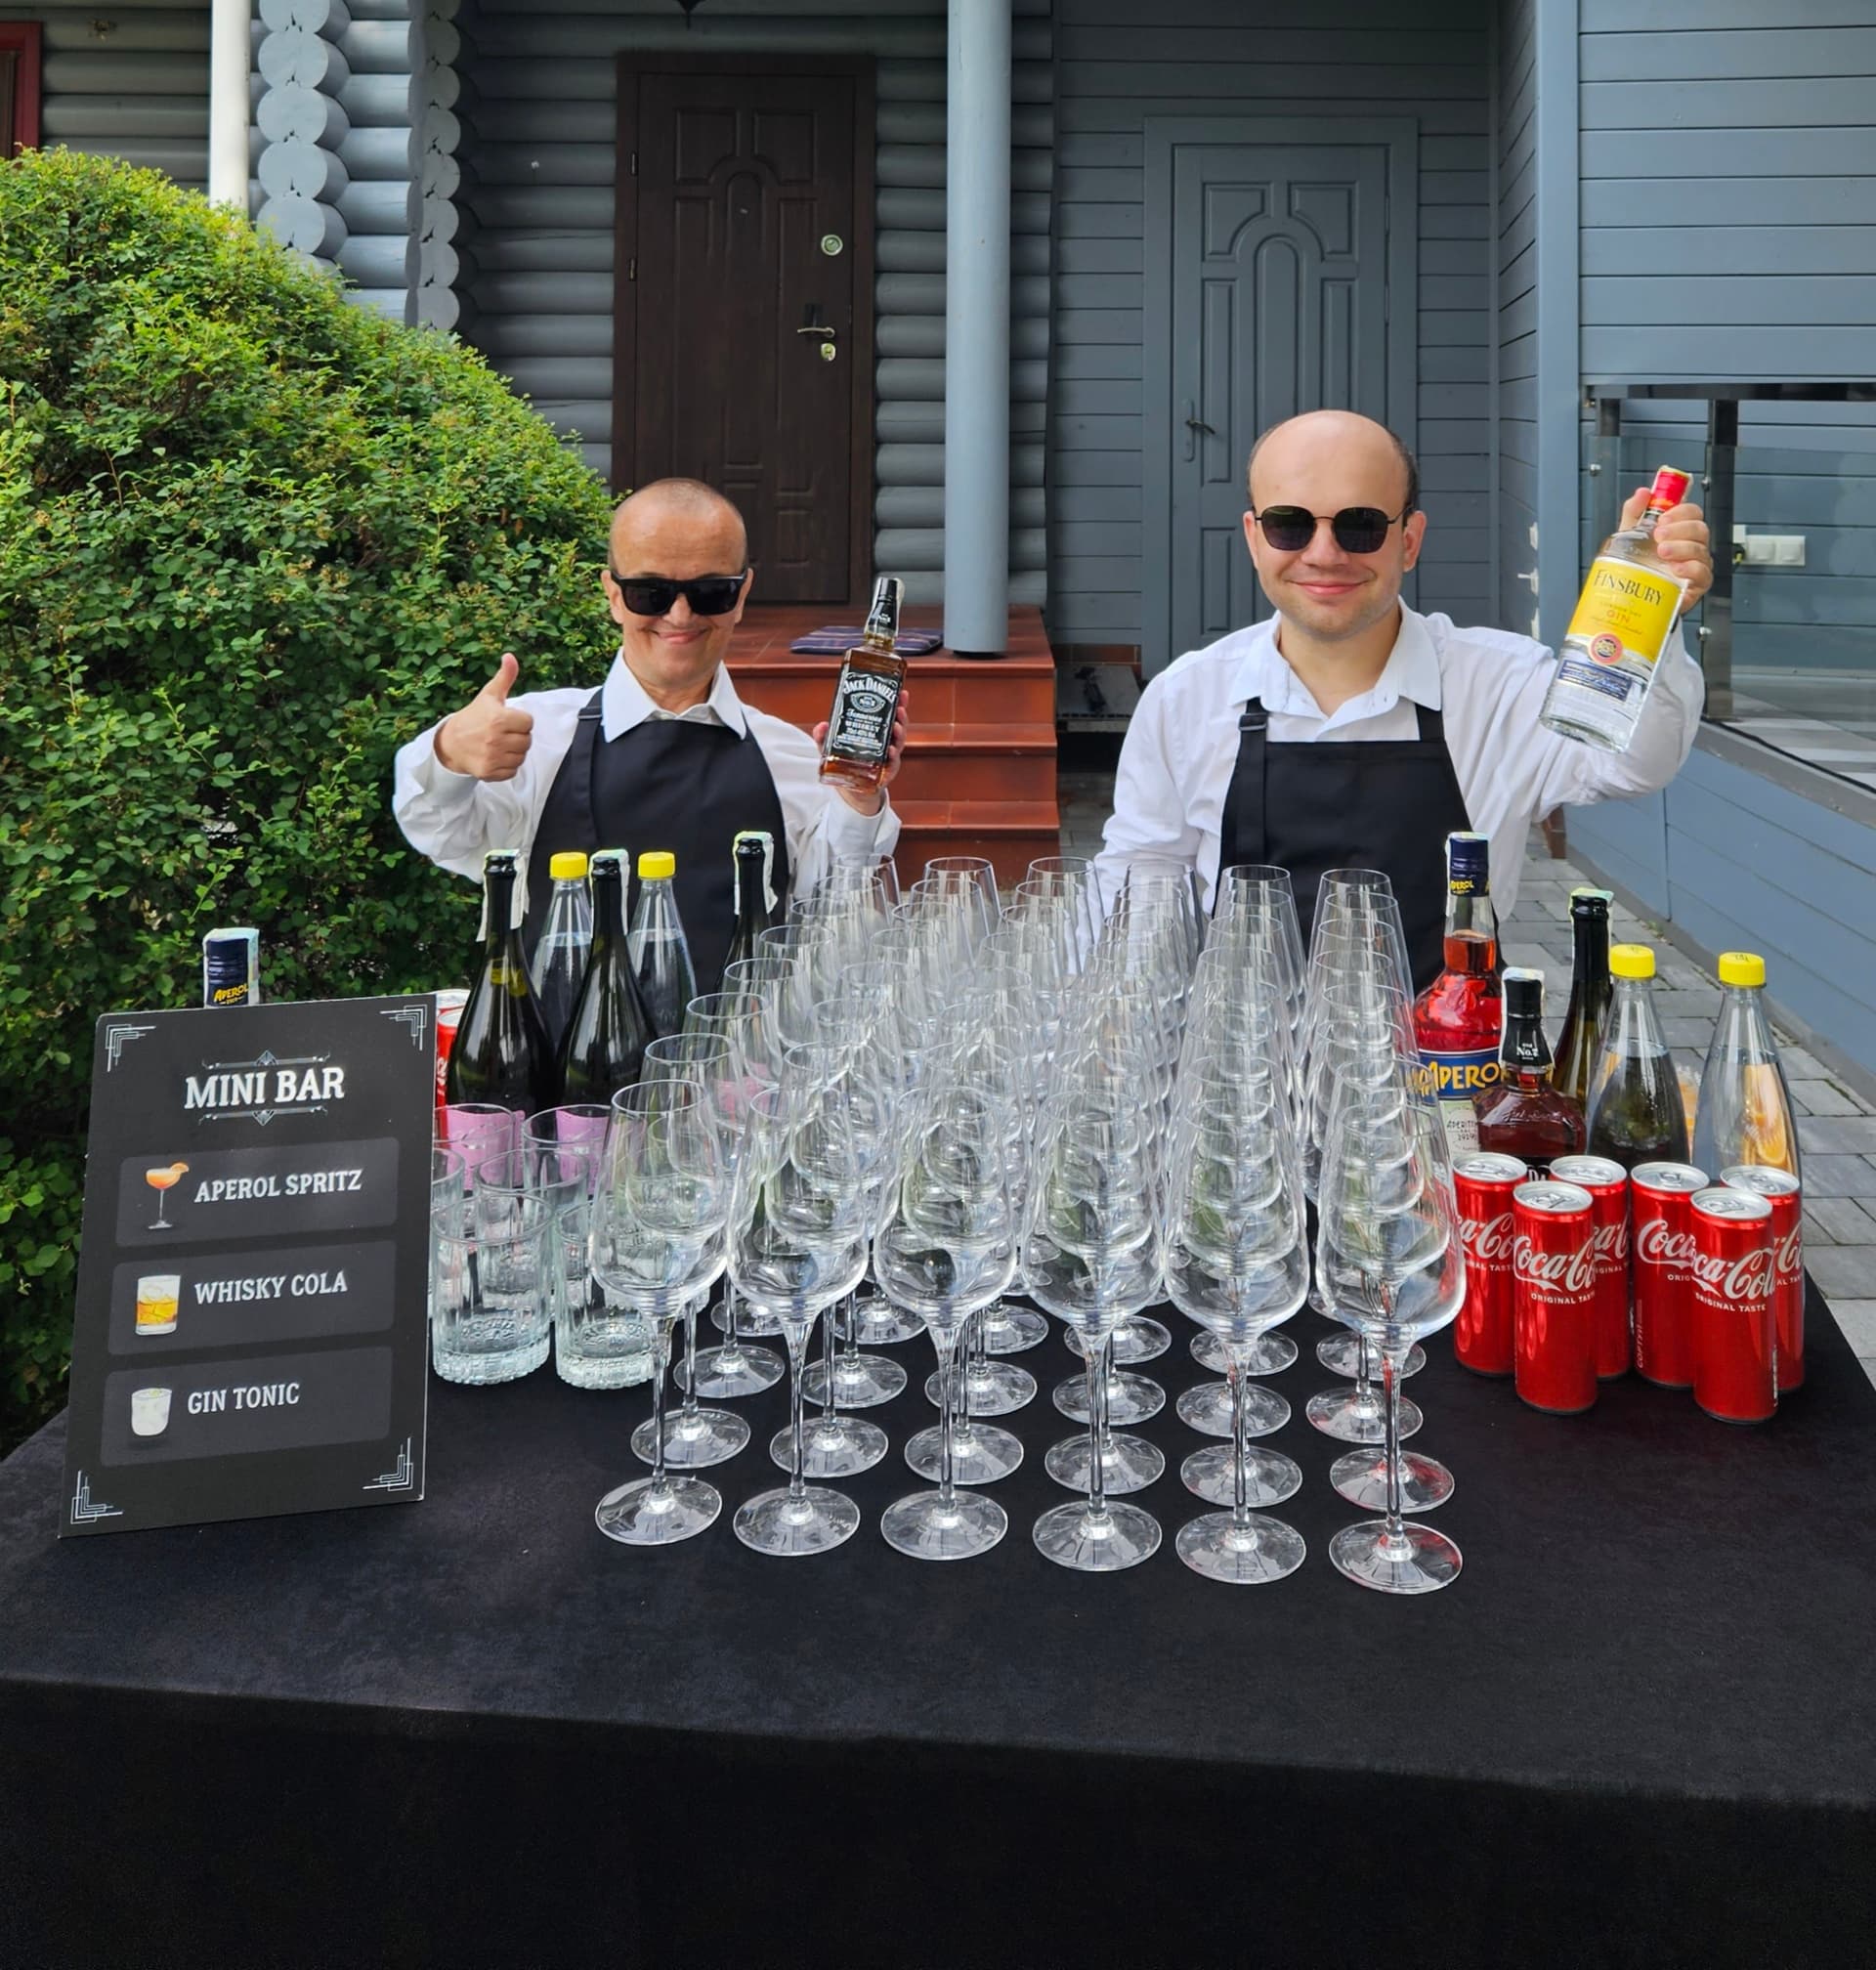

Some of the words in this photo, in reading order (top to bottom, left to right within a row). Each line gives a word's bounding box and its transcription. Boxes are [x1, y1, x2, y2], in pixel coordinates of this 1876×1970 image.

[1594, 570, 1663, 606] FINSBURY
[843, 679, 866, 695] JACK
[214, 983, 249, 1002] APEROL
[184, 1072, 268, 1109] MINI
[275, 1067, 345, 1102] BAR
[1419, 1061, 1501, 1096] APERO
[193, 1176, 281, 1203] APEROL
[285, 1169, 363, 1195] SPRITZ
[194, 1275, 286, 1305] WHISKY
[291, 1270, 348, 1296] COLA
[1531, 1292, 1576, 1305] ORIGINAL
[1739, 1304, 1766, 1312] TASTE
[188, 1390, 227, 1414] GIN
[233, 1383, 300, 1409] TONIC
